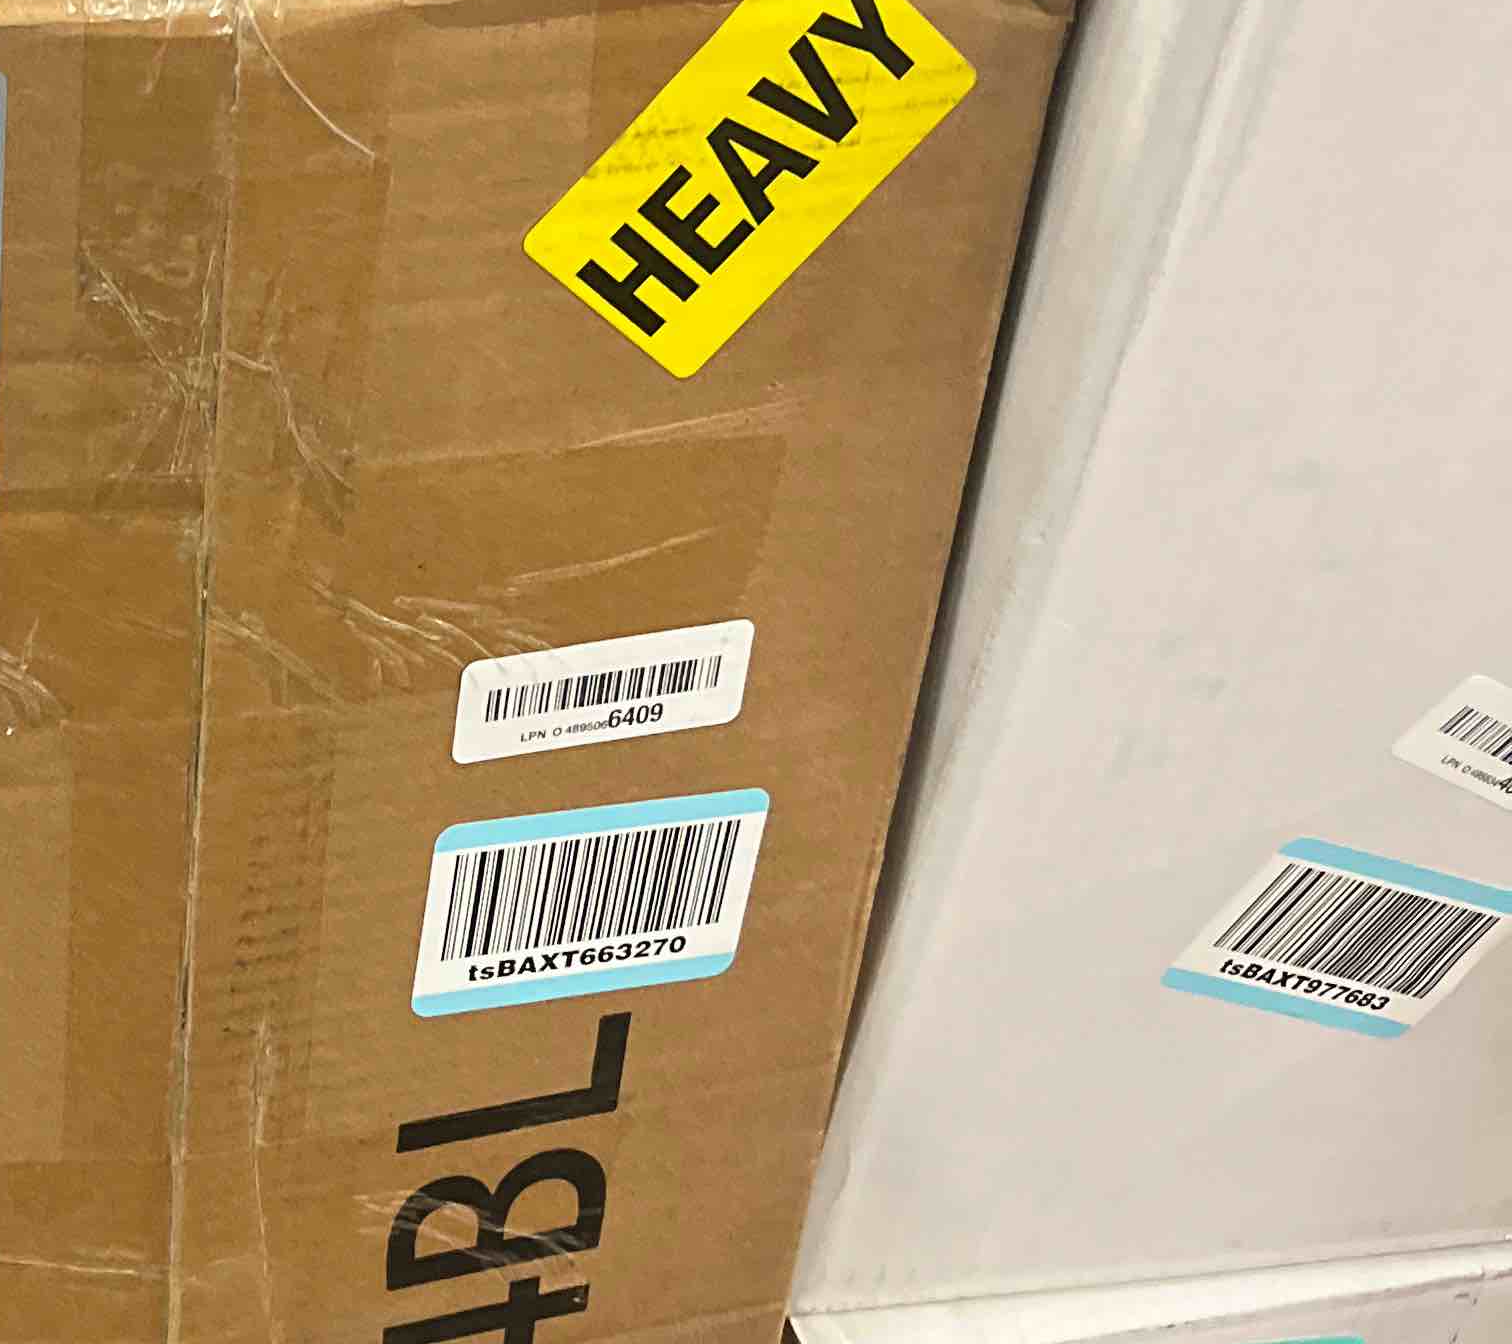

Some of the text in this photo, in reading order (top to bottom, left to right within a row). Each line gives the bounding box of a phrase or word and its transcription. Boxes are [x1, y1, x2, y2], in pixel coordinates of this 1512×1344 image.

[519, 727, 548, 743] LPN
[467, 935, 687, 983] tsBAXT663270
[1219, 959, 1390, 1012] tsBAXT977683
